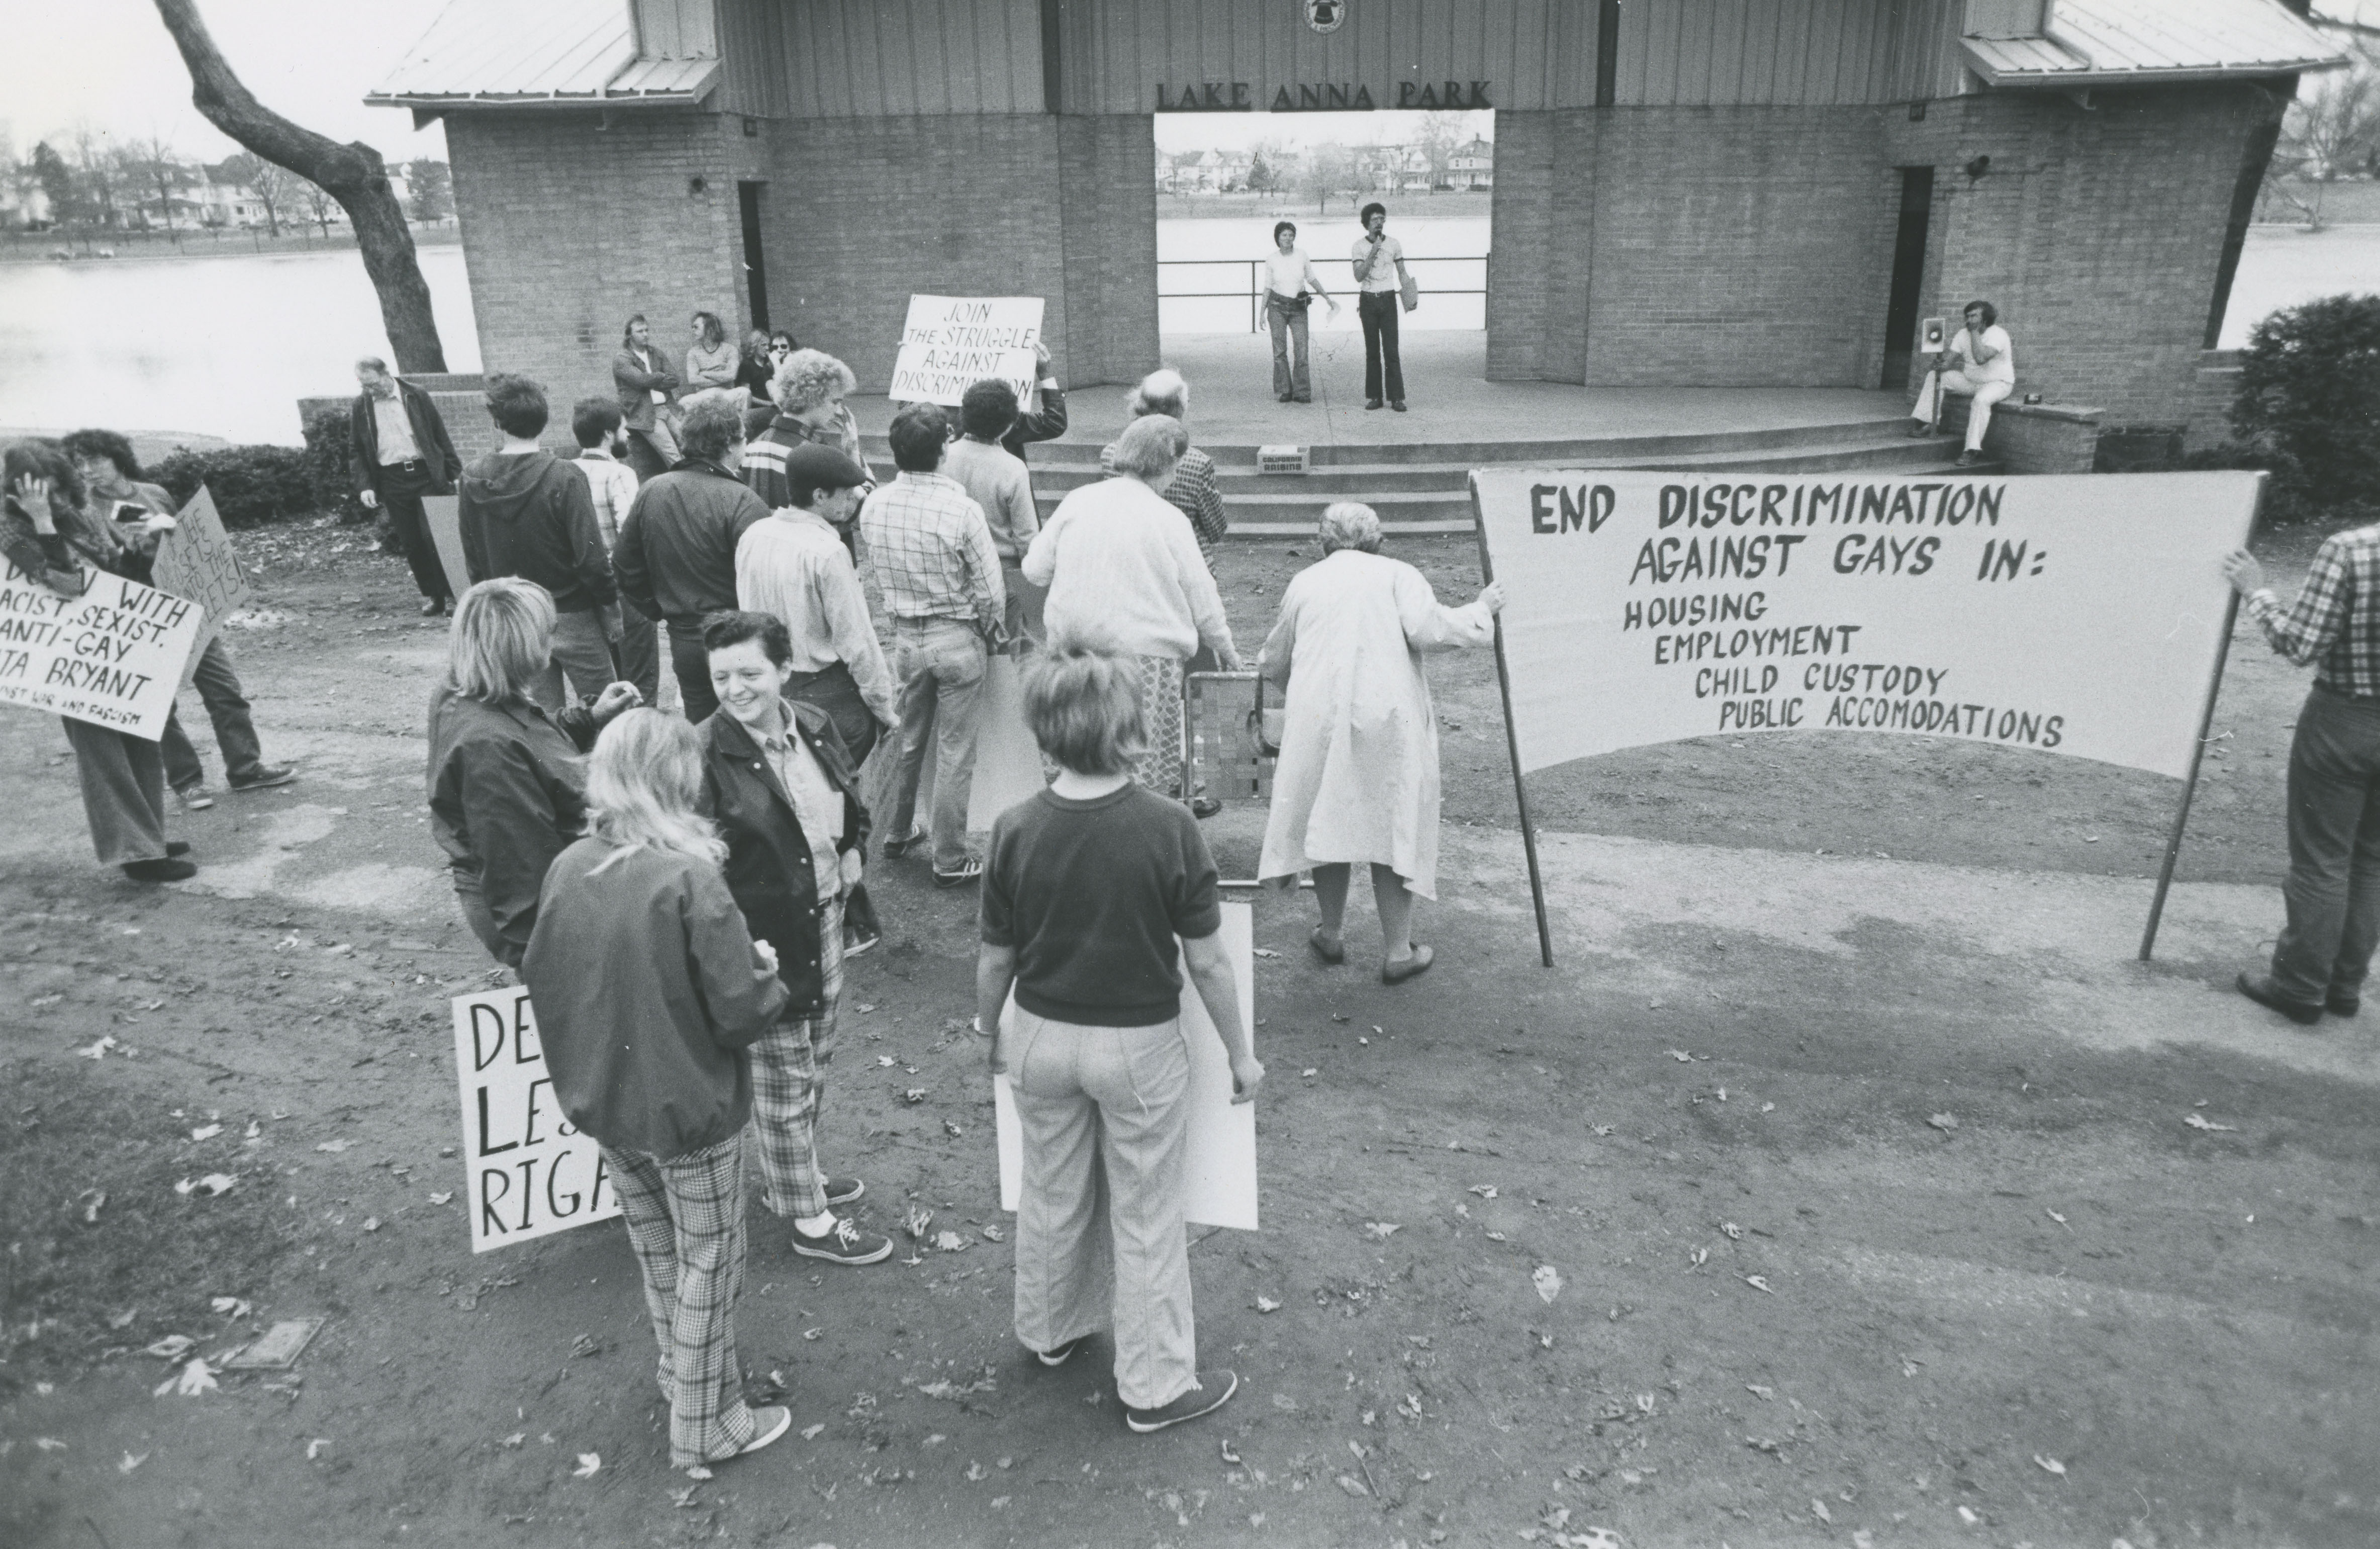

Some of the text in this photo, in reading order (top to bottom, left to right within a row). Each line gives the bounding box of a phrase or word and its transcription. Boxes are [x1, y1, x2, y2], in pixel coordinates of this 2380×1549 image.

[1156, 80, 1491, 109] LAKE ANNA PARK
[943, 303, 992, 323] JOIN
[909, 327, 1035, 348] THE STRUGGLE
[922, 349, 1005, 373] AGAINST
[894, 370, 1032, 401] DISCRIMION
[176, 507, 206, 544] THE
[1530, 482, 2007, 535] END DISCRIMINATION
[1628, 533, 2047, 586] AGAINST GAYS IN:
[0, 588, 168, 648] ACIST, SEXIST.
[119, 581, 191, 628] WITH
[1623, 590, 1769, 632] HOUSING
[0, 618, 133, 663] ANTI-GAY
[1654, 624, 1863, 665] EMPLOYMENT
[45, 656, 152, 701] BRYANT
[1694, 662, 1950, 699] CHILD CUSTODY
[61, 700, 85, 713] AND
[89, 703, 142, 724] FASCISM
[1718, 695, 2064, 748] PUBLIC ACCOMODATIONS
